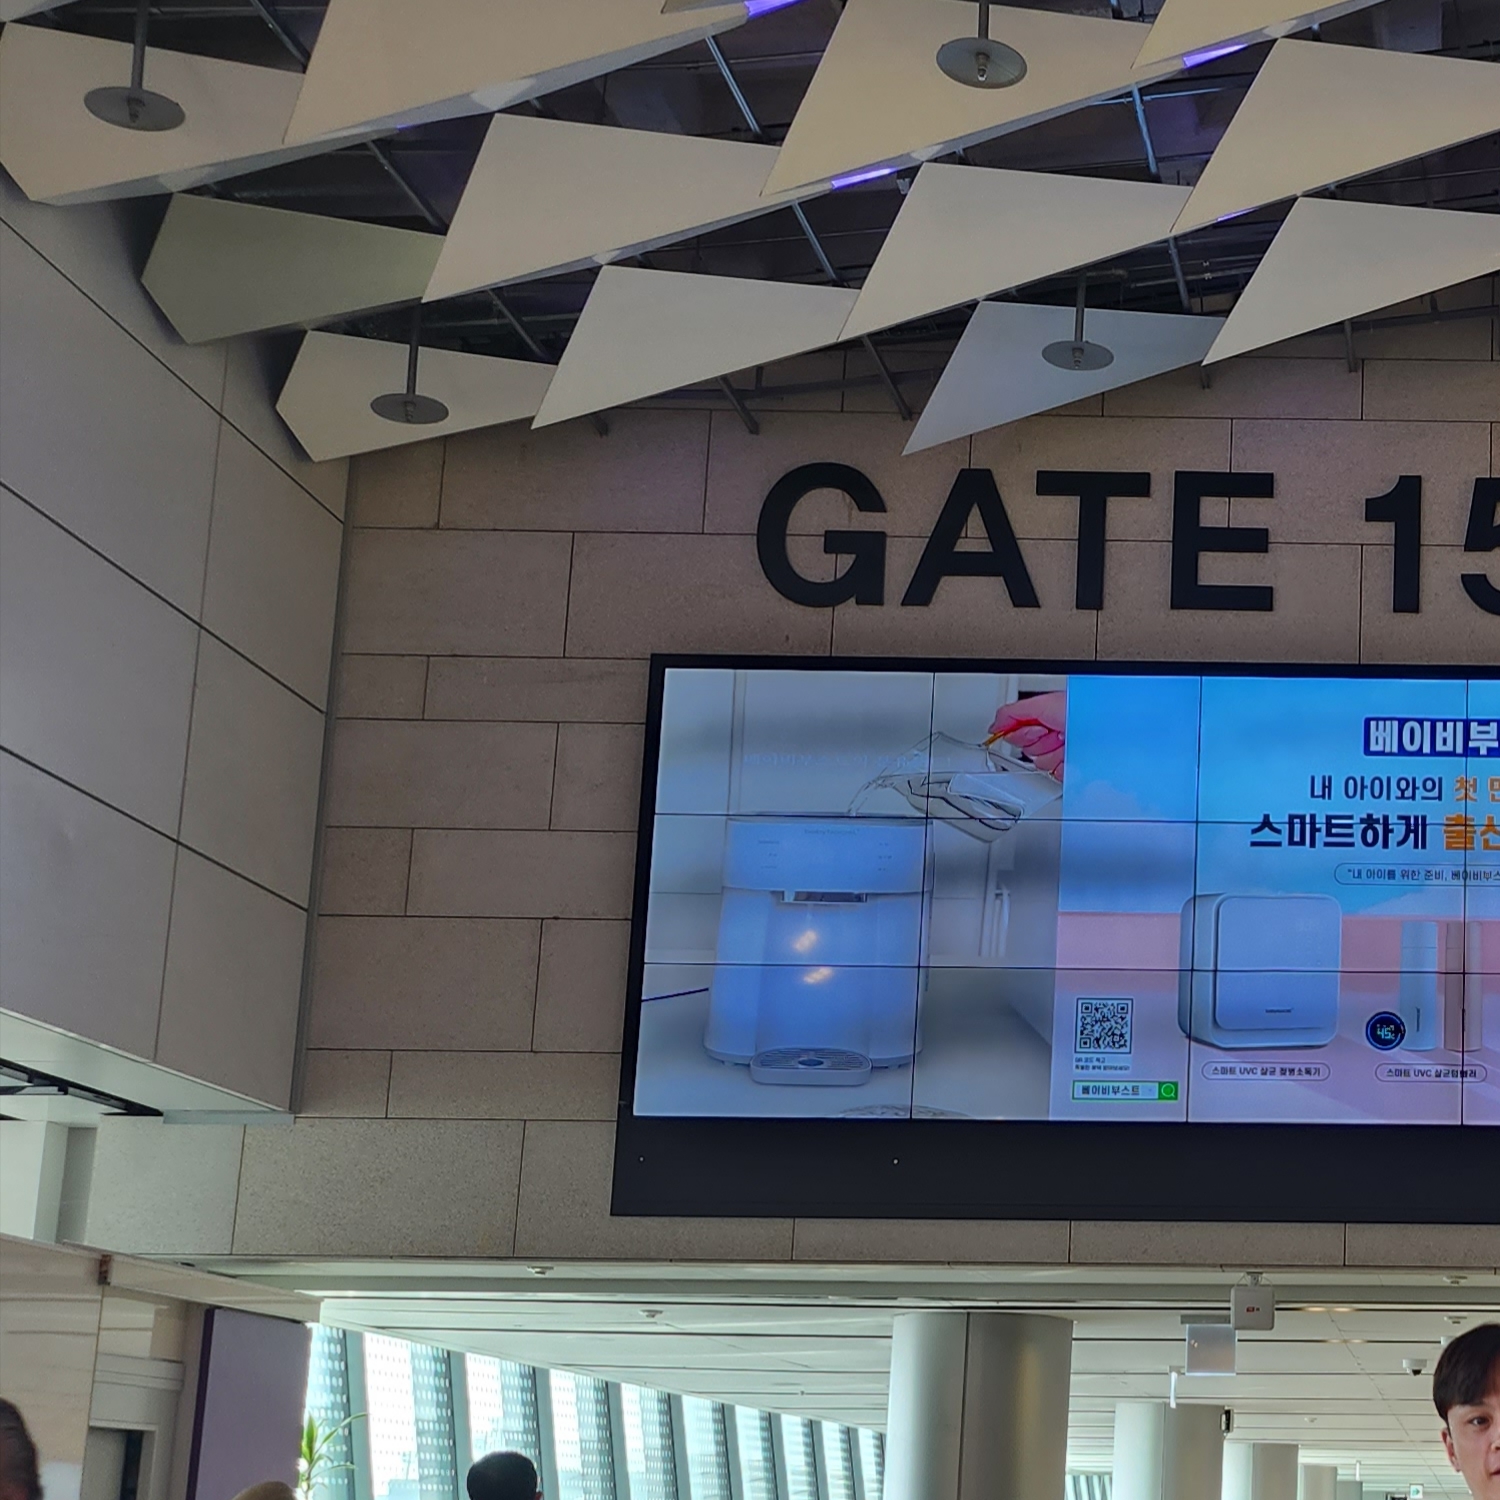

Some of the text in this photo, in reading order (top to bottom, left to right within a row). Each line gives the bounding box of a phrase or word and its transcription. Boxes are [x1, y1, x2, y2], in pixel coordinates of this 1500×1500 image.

[755, 461, 1275, 613] GATE
[1309, 774, 1334, 802] 내
[1344, 774, 1444, 803] 아이와의
[1453, 775, 1479, 804] 첫
[1249, 812, 1429, 851] 스마트하게
[1366, 868, 1396, 881] 아이를
[1400, 869, 1421, 881] 위한
[1211, 1066, 1237, 1076] 스마트
[1239, 1067, 1258, 1076] UVC
[1385, 1068, 1411, 1078] 스마트
[1413, 1069, 1432, 1078] UVC
[1081, 1084, 1140, 1096] 베이비부스트
